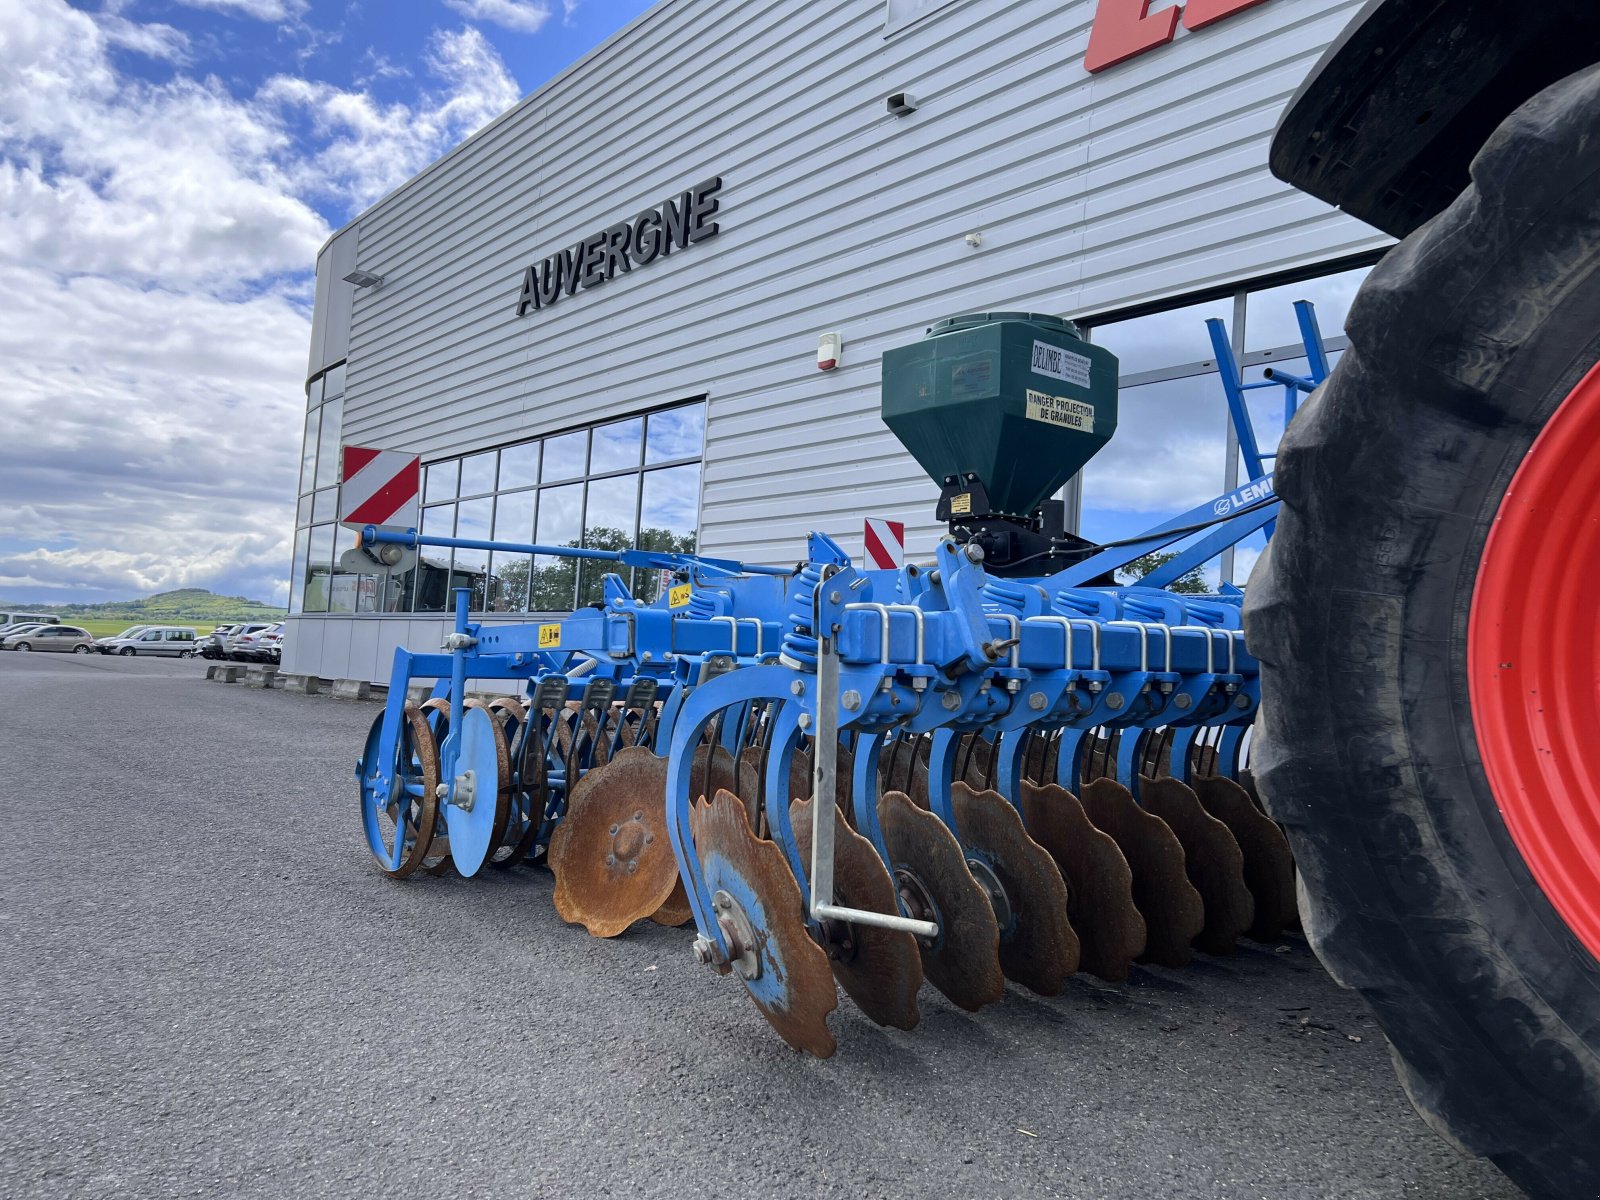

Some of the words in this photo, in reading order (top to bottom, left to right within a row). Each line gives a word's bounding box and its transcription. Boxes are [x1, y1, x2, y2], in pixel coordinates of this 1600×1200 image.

[516, 177, 722, 316] AUVERGNE
[1032, 345, 1062, 374] DELIMBE
[1028, 393, 1054, 410] DANGER
[1056, 400, 1093, 418] PROJECTION
[1040, 408, 1049, 419] DE
[1050, 410, 1083, 427] GRANULES
